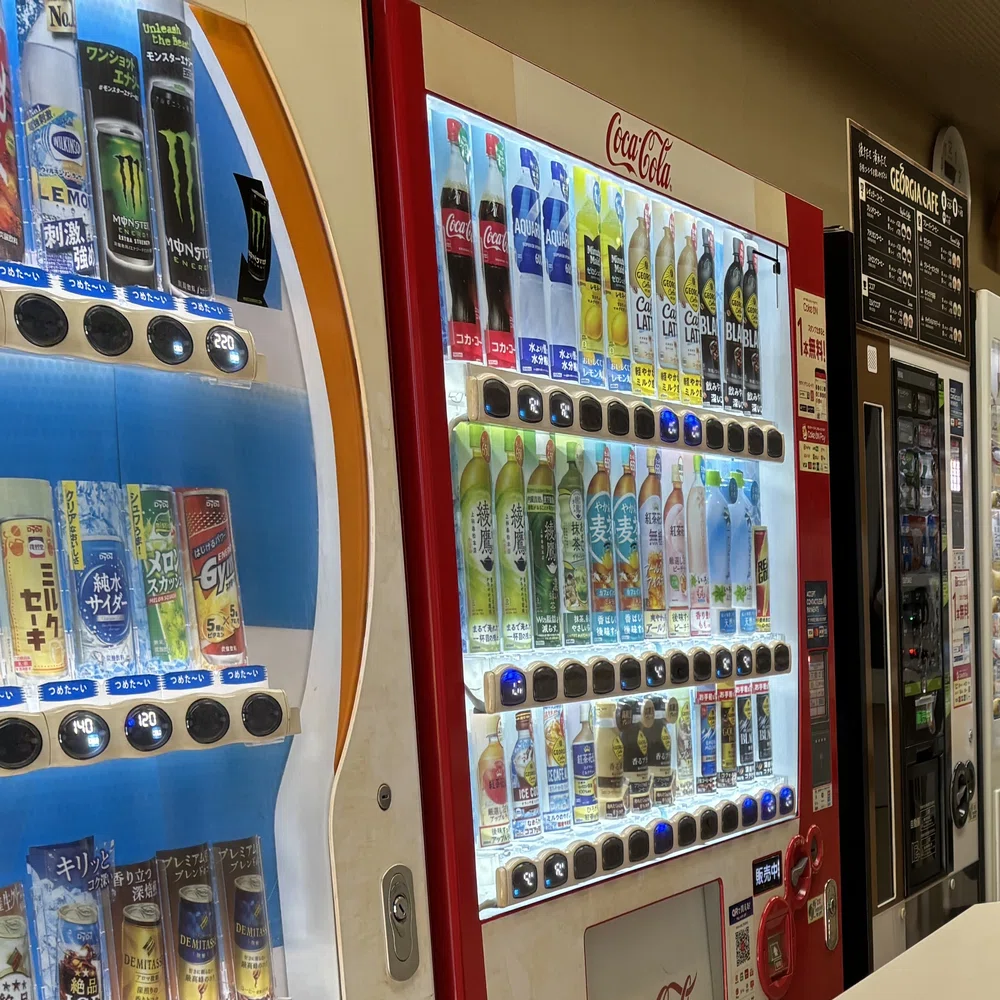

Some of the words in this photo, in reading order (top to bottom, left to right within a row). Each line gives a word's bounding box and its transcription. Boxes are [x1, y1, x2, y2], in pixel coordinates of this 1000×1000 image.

[143, 22, 181, 35] Unleash
[152, 34, 171, 46] the
[605, 111, 674, 191] Coca-Cola
[890, 163, 922, 206] GEORGIA
[922, 186, 939, 215] CAFE
[213, 333, 235, 350] 220
[93, 572, 122, 594] 純水
[40, 563, 59, 638] ミルク
[85, 594, 128, 615] サイダー
[20, 588, 46, 652] セーキ
[73, 718, 93, 735] 140
[138, 711, 157, 727] 120
[57, 848, 110, 882] キリッと
[113, 868, 152, 888] 香り立つ
[71, 977, 98, 996] 絶品
